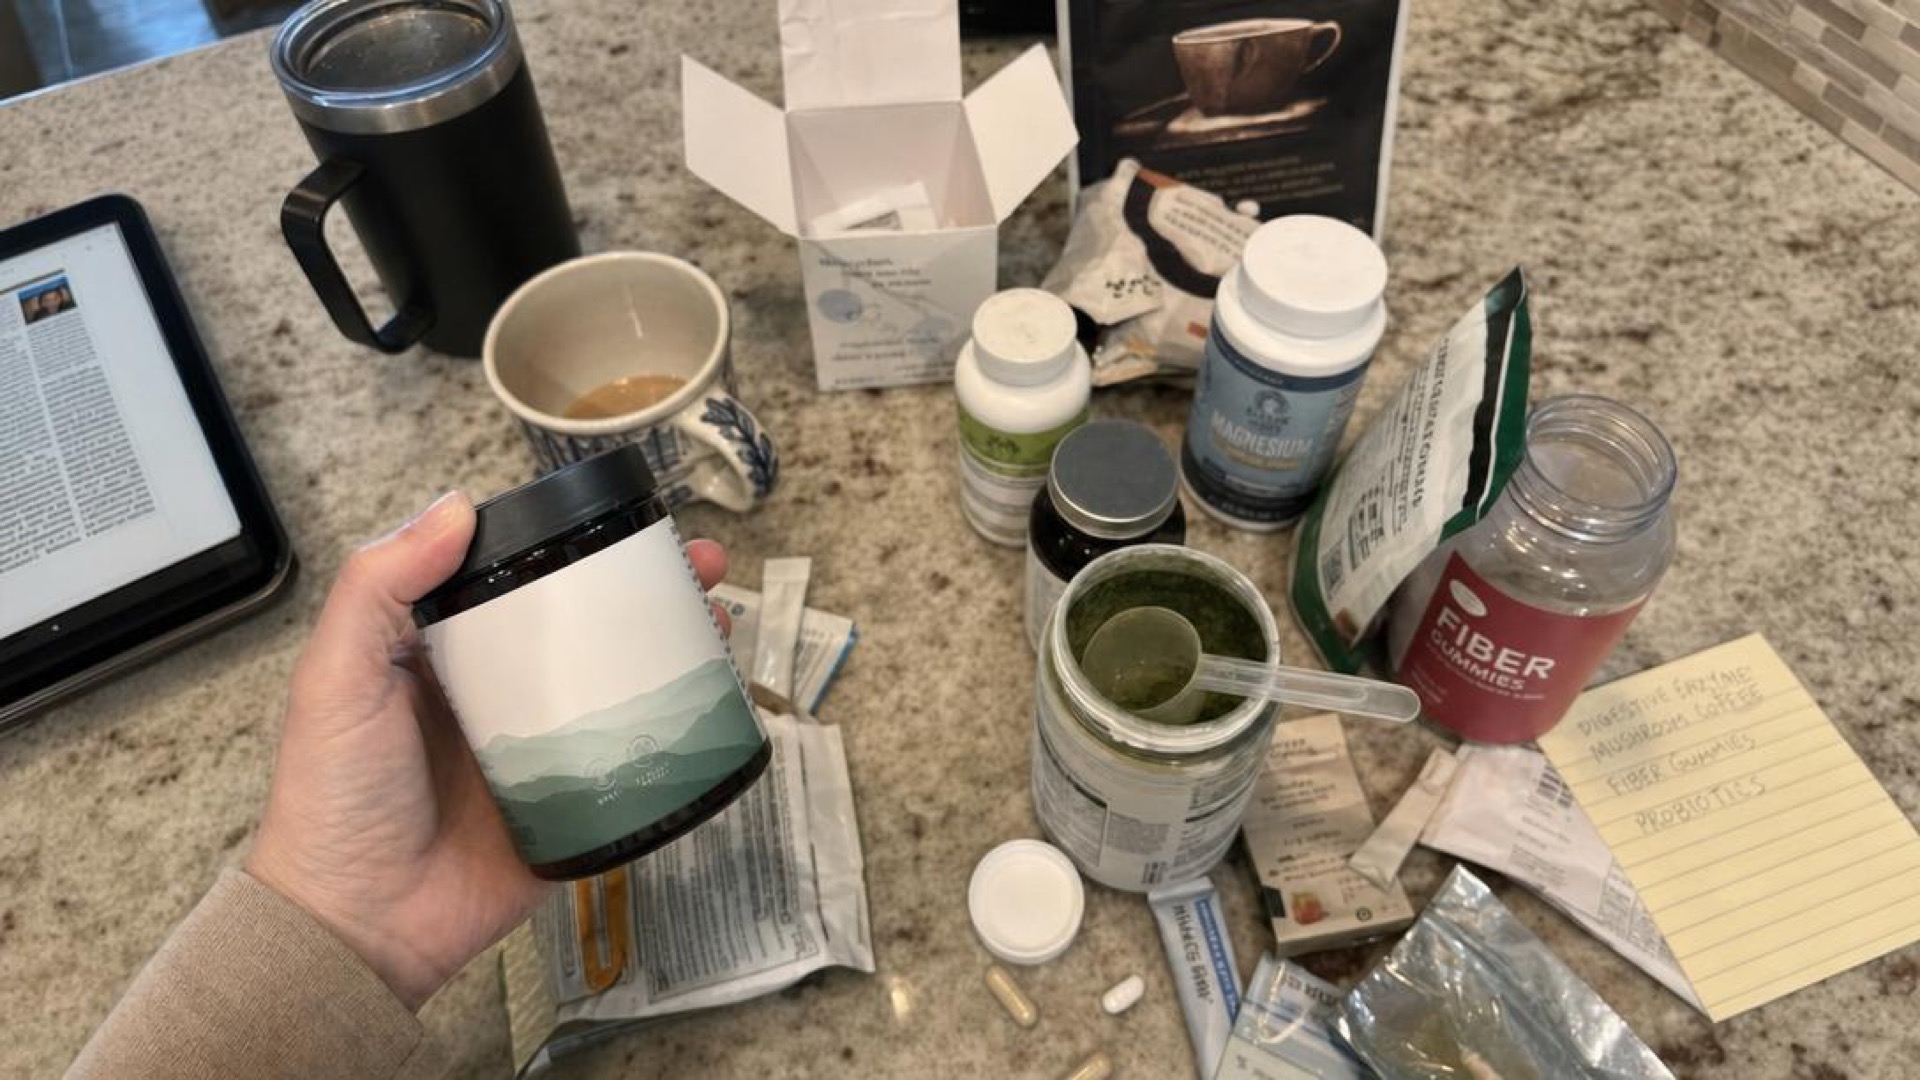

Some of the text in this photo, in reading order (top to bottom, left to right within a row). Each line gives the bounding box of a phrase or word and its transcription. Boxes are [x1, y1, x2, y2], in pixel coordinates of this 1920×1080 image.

[1431, 629, 1526, 690] GUMMIES
[1437, 606, 1555, 679] FIBER
[1577, 686, 1667, 737] DIGESTIVE
[1606, 763, 1662, 797] FIBER
[1634, 775, 1766, 836] PROBIOTICS
